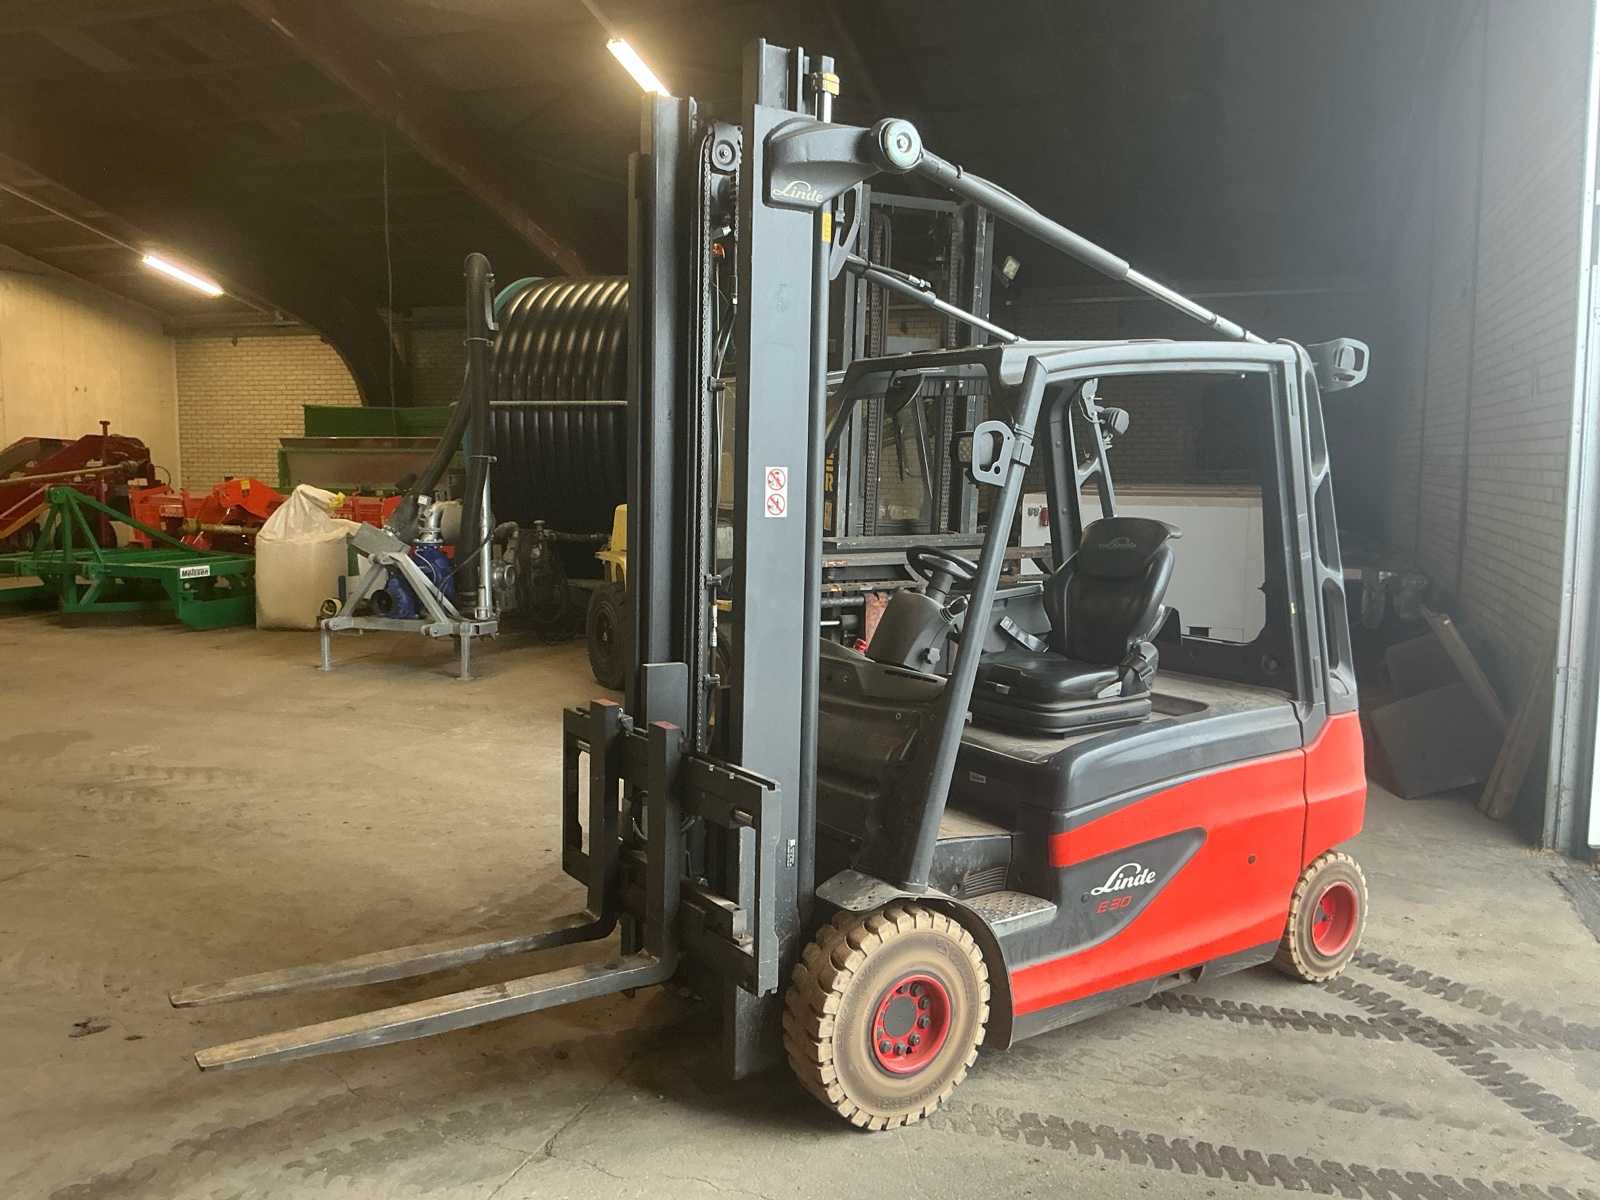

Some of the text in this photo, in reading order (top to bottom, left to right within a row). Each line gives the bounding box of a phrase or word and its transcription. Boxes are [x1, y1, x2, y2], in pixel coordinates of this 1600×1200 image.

[772, 180, 824, 203] Linde
[1090, 862, 1156, 896] Linde
[1096, 895, 1132, 914] E30
